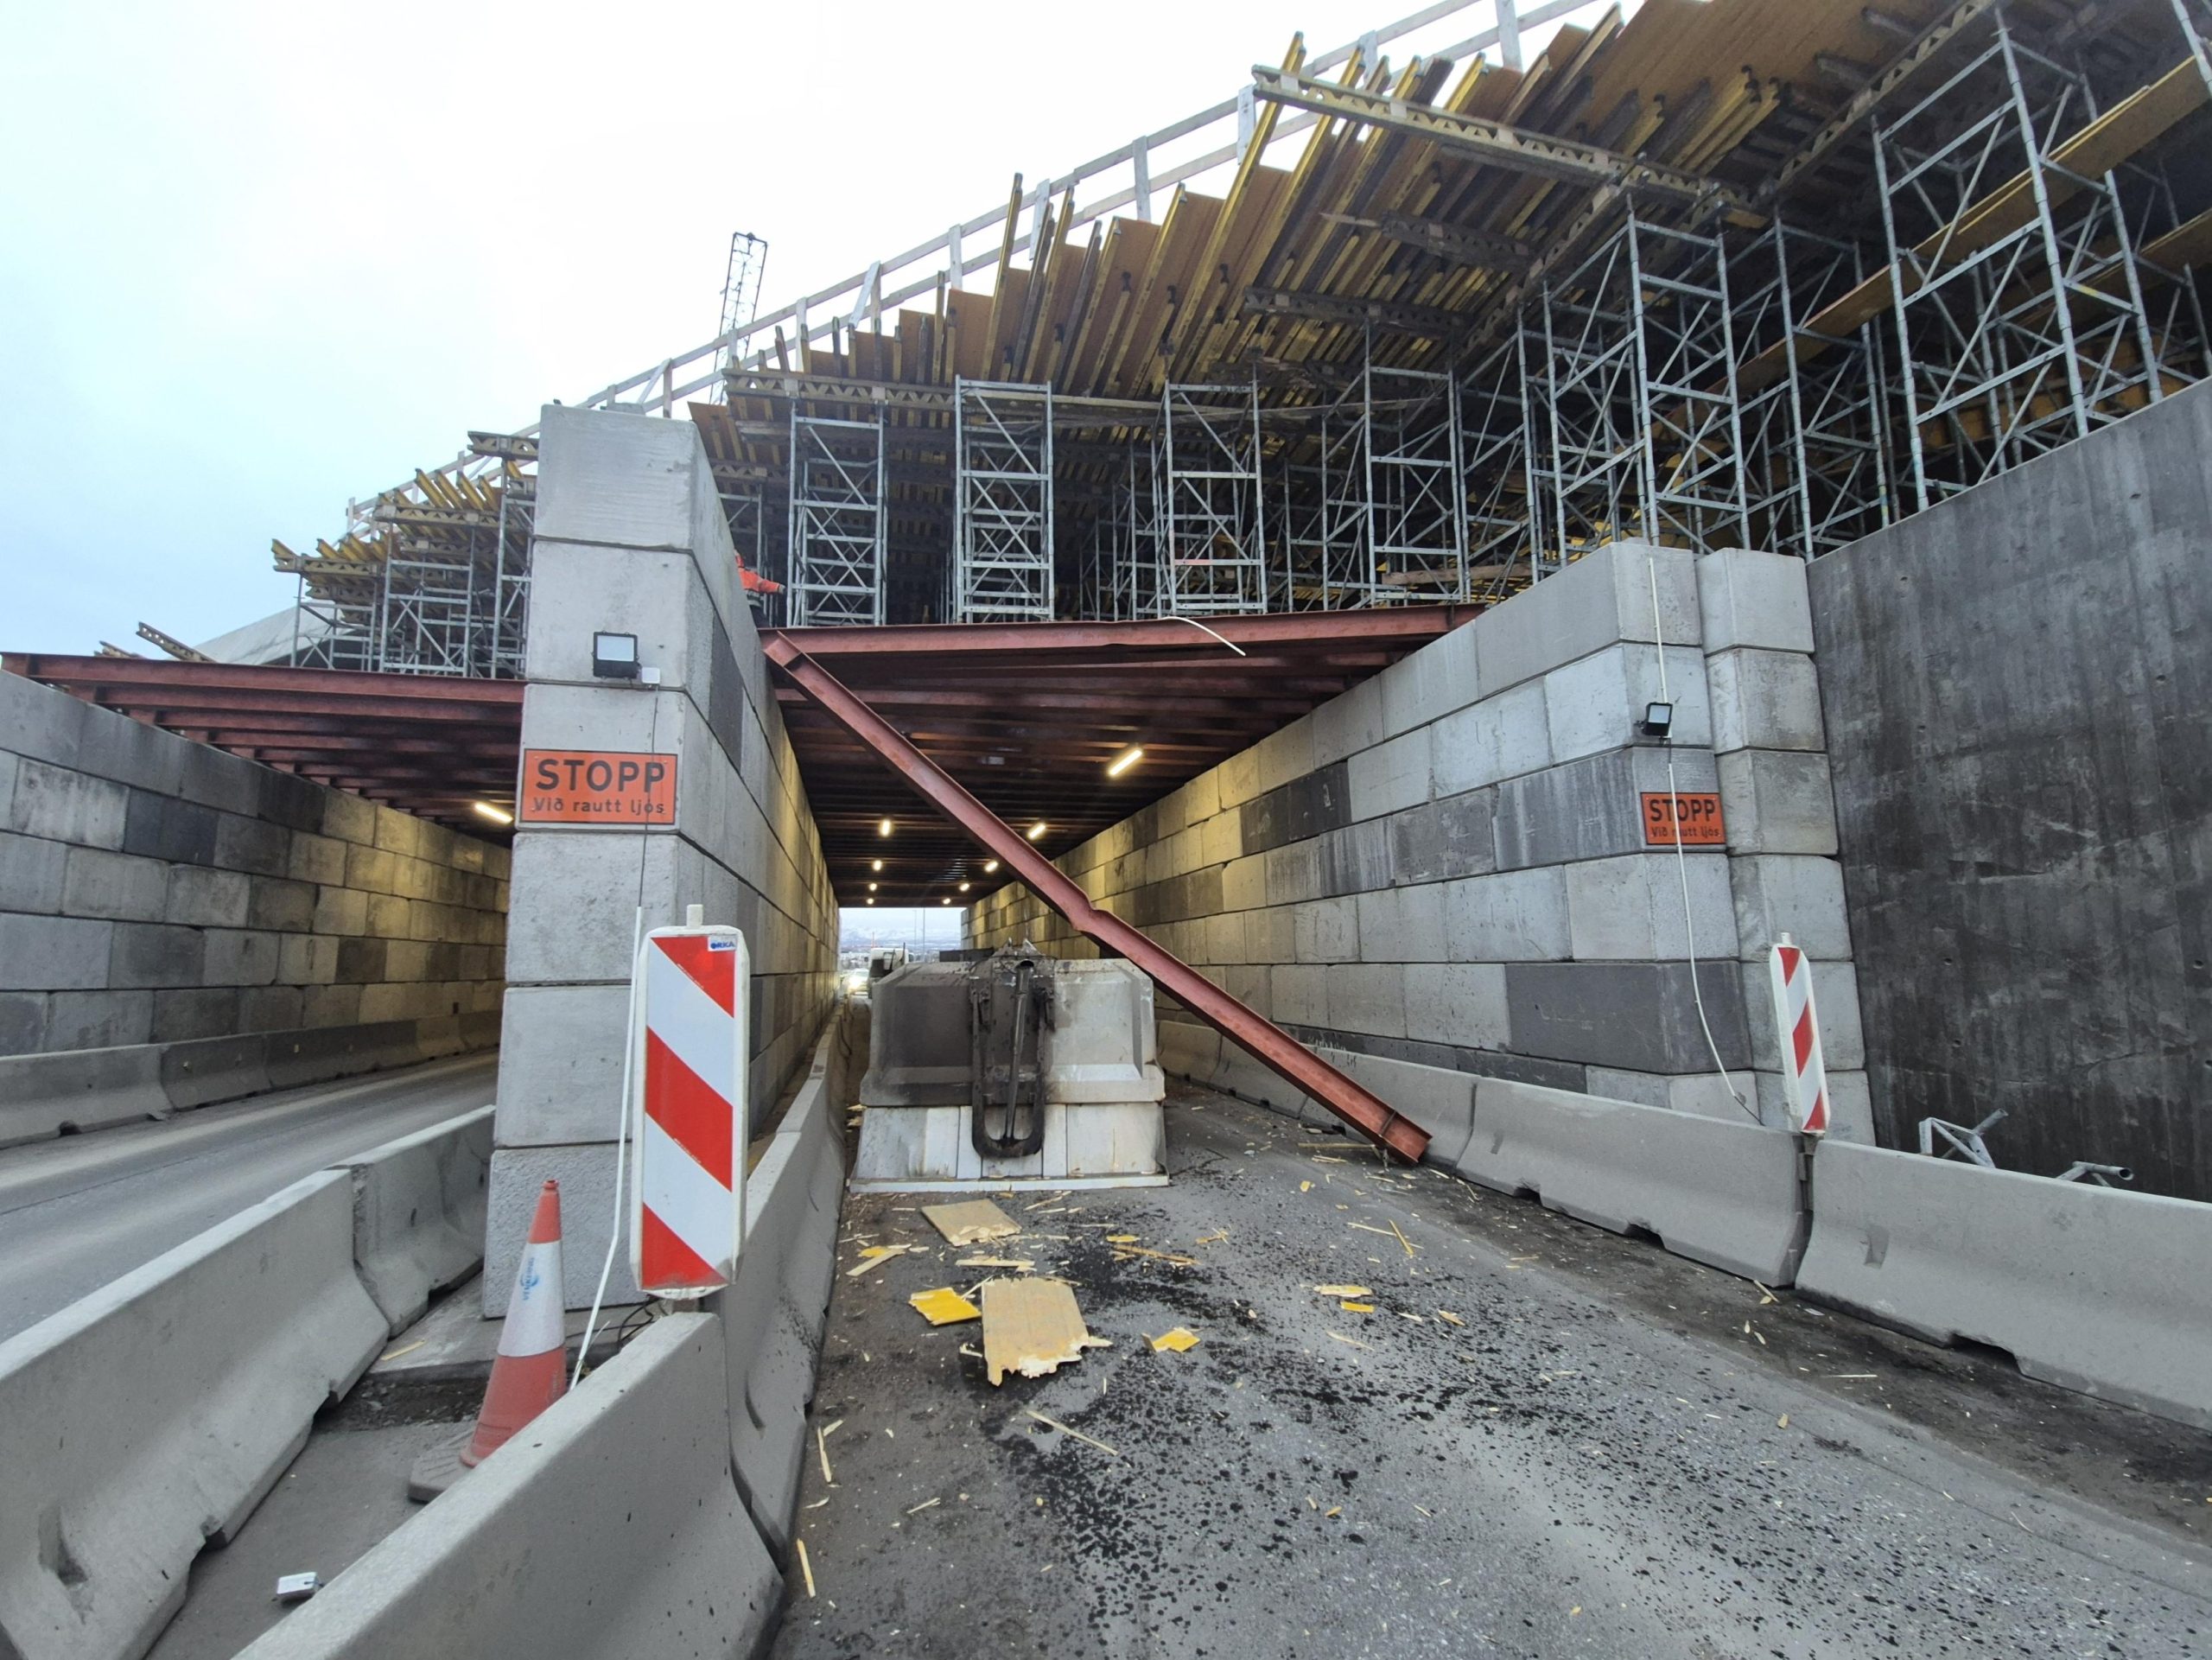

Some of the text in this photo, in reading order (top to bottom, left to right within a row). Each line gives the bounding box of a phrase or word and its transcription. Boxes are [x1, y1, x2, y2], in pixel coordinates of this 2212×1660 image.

[536, 759, 664, 792] STOPP
[534, 797, 563, 811] Við
[573, 799, 621, 813] rautt
[1649, 799, 1715, 822] STOPP
[1671, 827, 1697, 836] rutt
